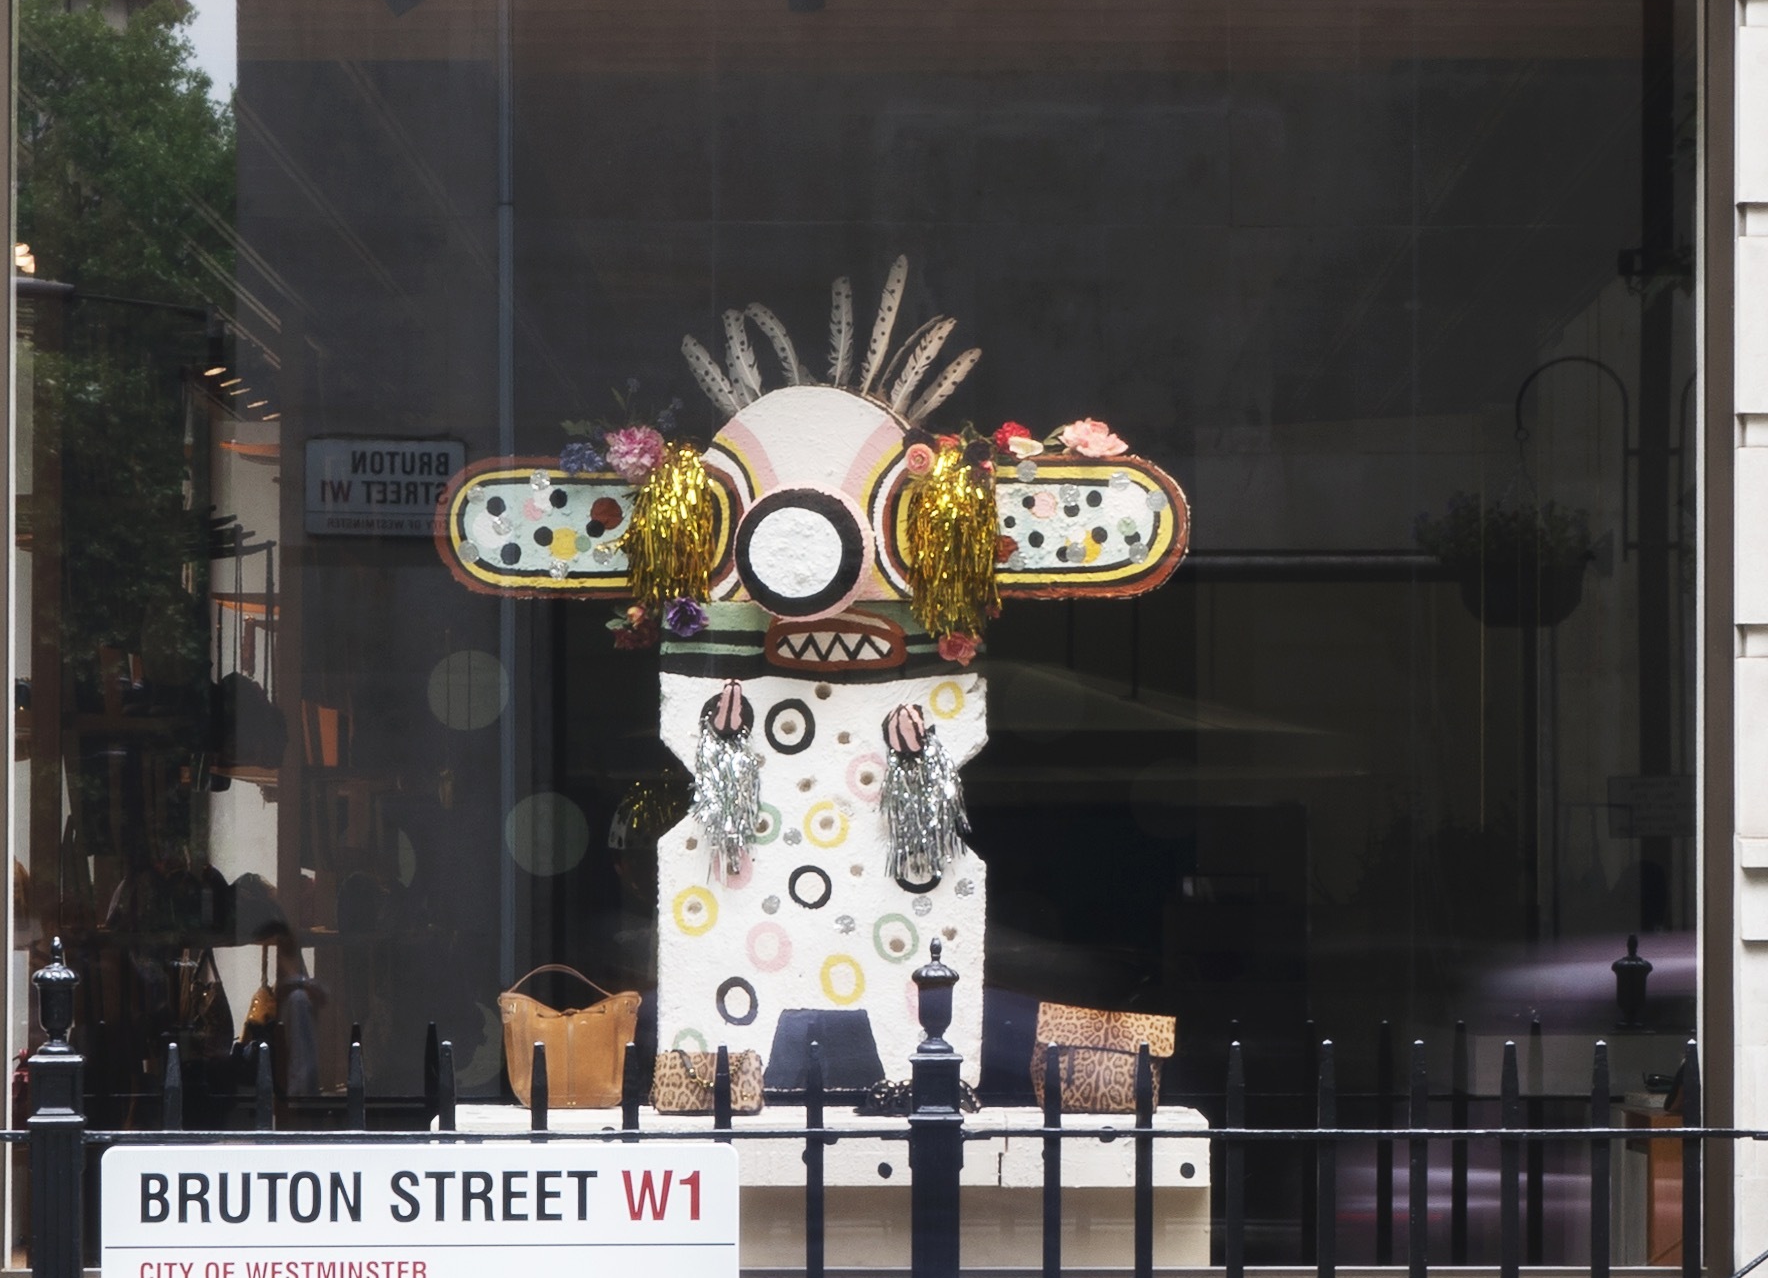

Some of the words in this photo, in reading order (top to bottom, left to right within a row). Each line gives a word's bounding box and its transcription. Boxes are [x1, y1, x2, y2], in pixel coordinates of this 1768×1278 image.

[140, 1171, 362, 1224] BRUTON
[389, 1170, 598, 1222] STREET
[621, 1169, 702, 1221] W1
